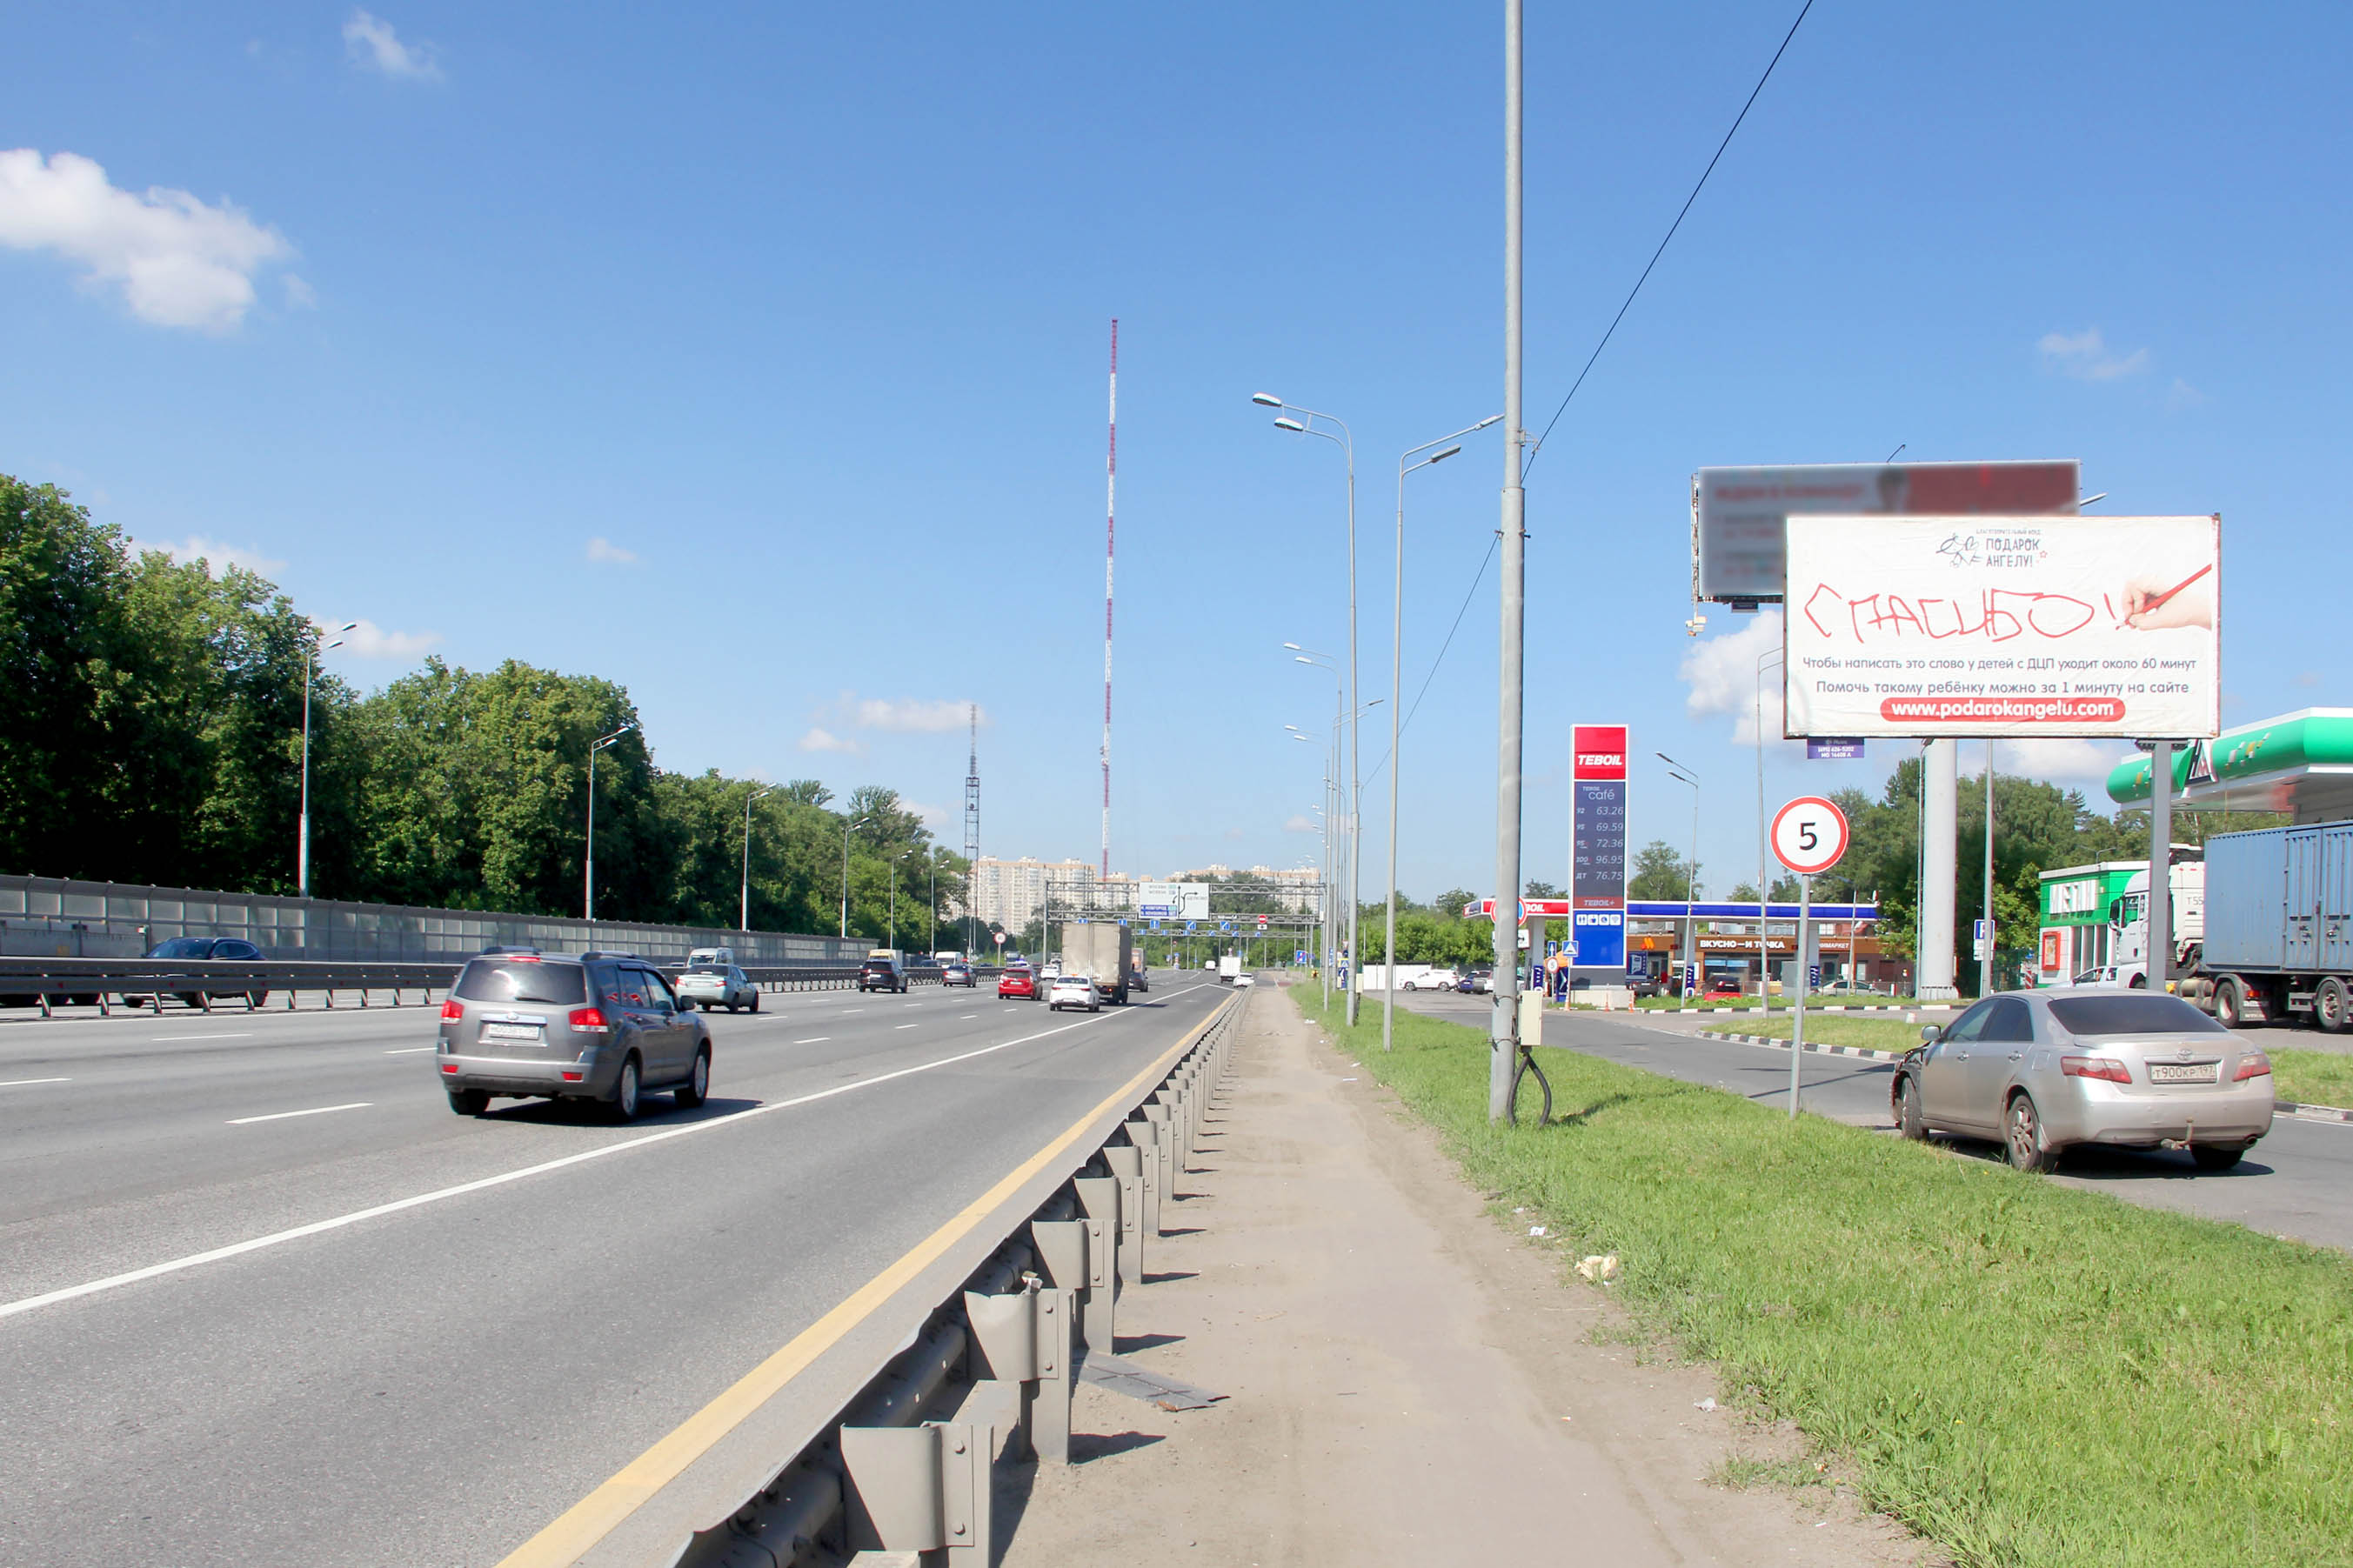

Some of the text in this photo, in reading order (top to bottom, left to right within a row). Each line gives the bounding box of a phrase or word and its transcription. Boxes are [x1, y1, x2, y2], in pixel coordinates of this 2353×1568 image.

[1985, 537, 2040, 552] ПОДАРОК
[1986, 554, 2033, 567] АНГЕЛУ!
[1803, 657, 2196, 671] Чтобы написать это слово у детей с ДЦП уходит около 60 минут
[1816, 681, 2189, 696] Помочь такому ребёнку можно за 1 минуту на сайте
[1891, 698, 2115, 720] www.podarokangelu.com
[1578, 754, 1622, 766] TEBOIL
[1588, 789, 1615, 800] café
[1596, 806, 1623, 816] 63.26
[1596, 823, 1623, 831] 69.59
[1799, 822, 1817, 851] 5
[1596, 839, 1623, 848] 72.36
[1595, 856, 1623, 864] 96.95
[1596, 871, 1623, 880] 76.75
[2156, 1065, 2214, 1078] Т900КР 197
